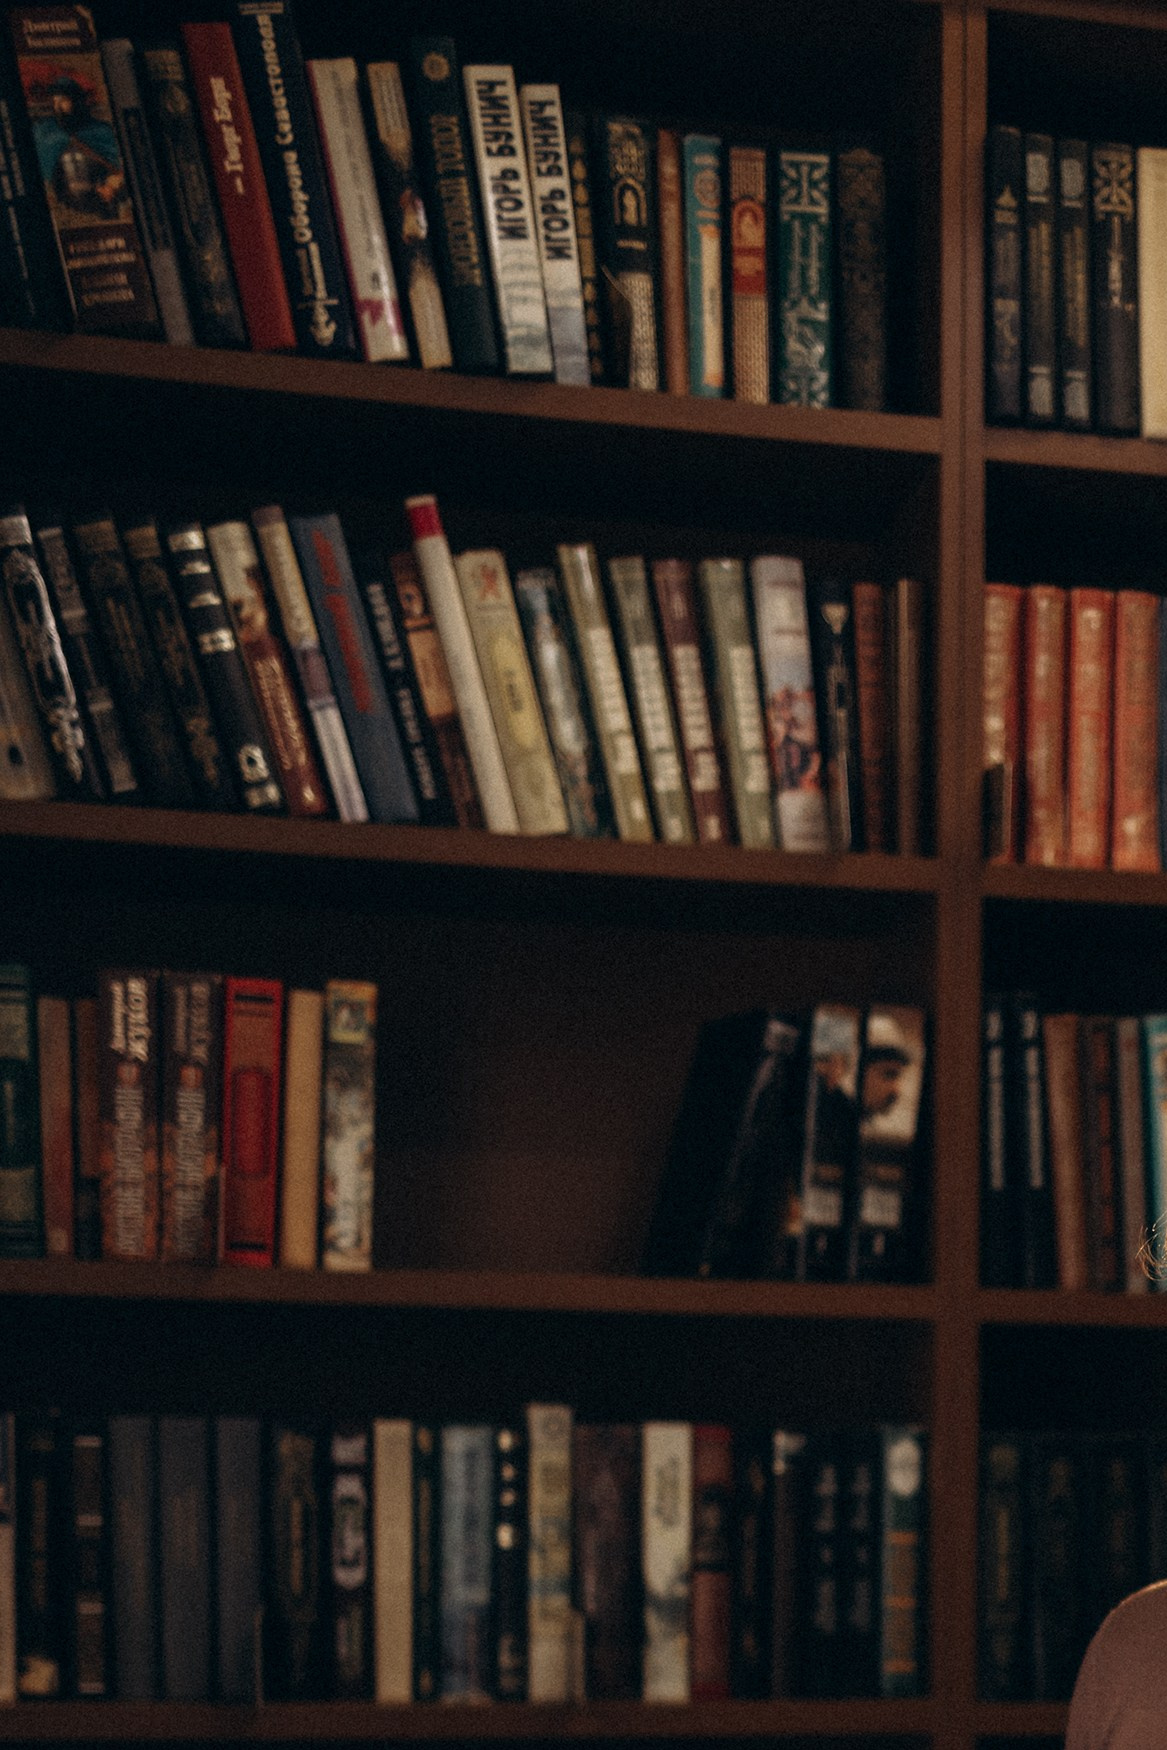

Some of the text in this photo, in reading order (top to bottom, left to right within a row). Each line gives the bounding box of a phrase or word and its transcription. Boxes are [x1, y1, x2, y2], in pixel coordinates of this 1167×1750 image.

[476, 79, 529, 241] ИГОРЬ БУНИЧ
[528, 99, 573, 260] ИГОРЬ БУНИЧ
